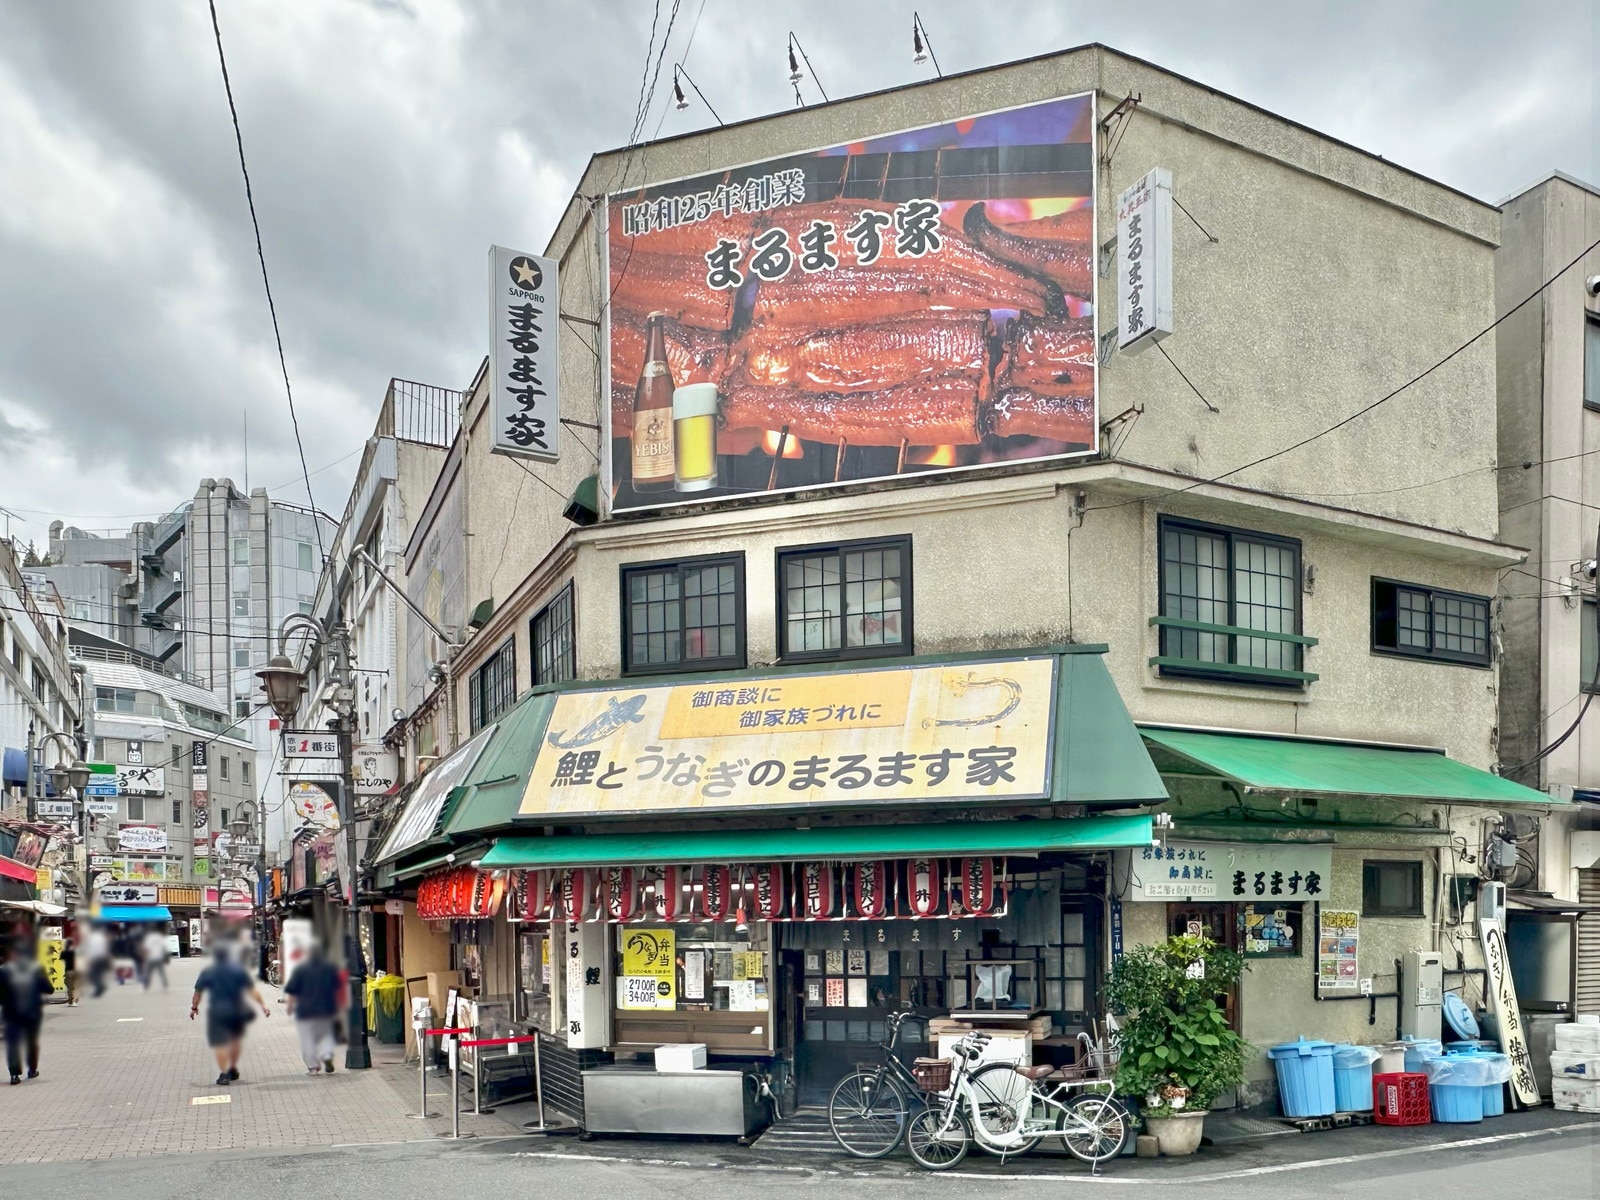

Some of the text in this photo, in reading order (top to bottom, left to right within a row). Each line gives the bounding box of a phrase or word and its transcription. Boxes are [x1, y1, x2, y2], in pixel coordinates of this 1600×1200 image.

[622, 168, 806, 236] 昭和25年創業
[705, 198, 943, 290] まるます家
[1127, 214, 1144, 334] まるます家
[509, 287, 545, 303] SAPPORO
[504, 302, 549, 450] まるます家
[691, 687, 783, 709] 御商談に
[739, 703, 882, 728] 御家族づれに
[298, 739, 336, 753] 1番街
[356, 777, 392, 788] にしのや
[550, 745, 1017, 798] 鯉とうなぎのまるます家
[1232, 870, 1323, 896] まるます家
[658, 938, 671, 967] 弁当
[628, 978, 656, 992] 2700円
[628, 990, 656, 1003] 3400円
